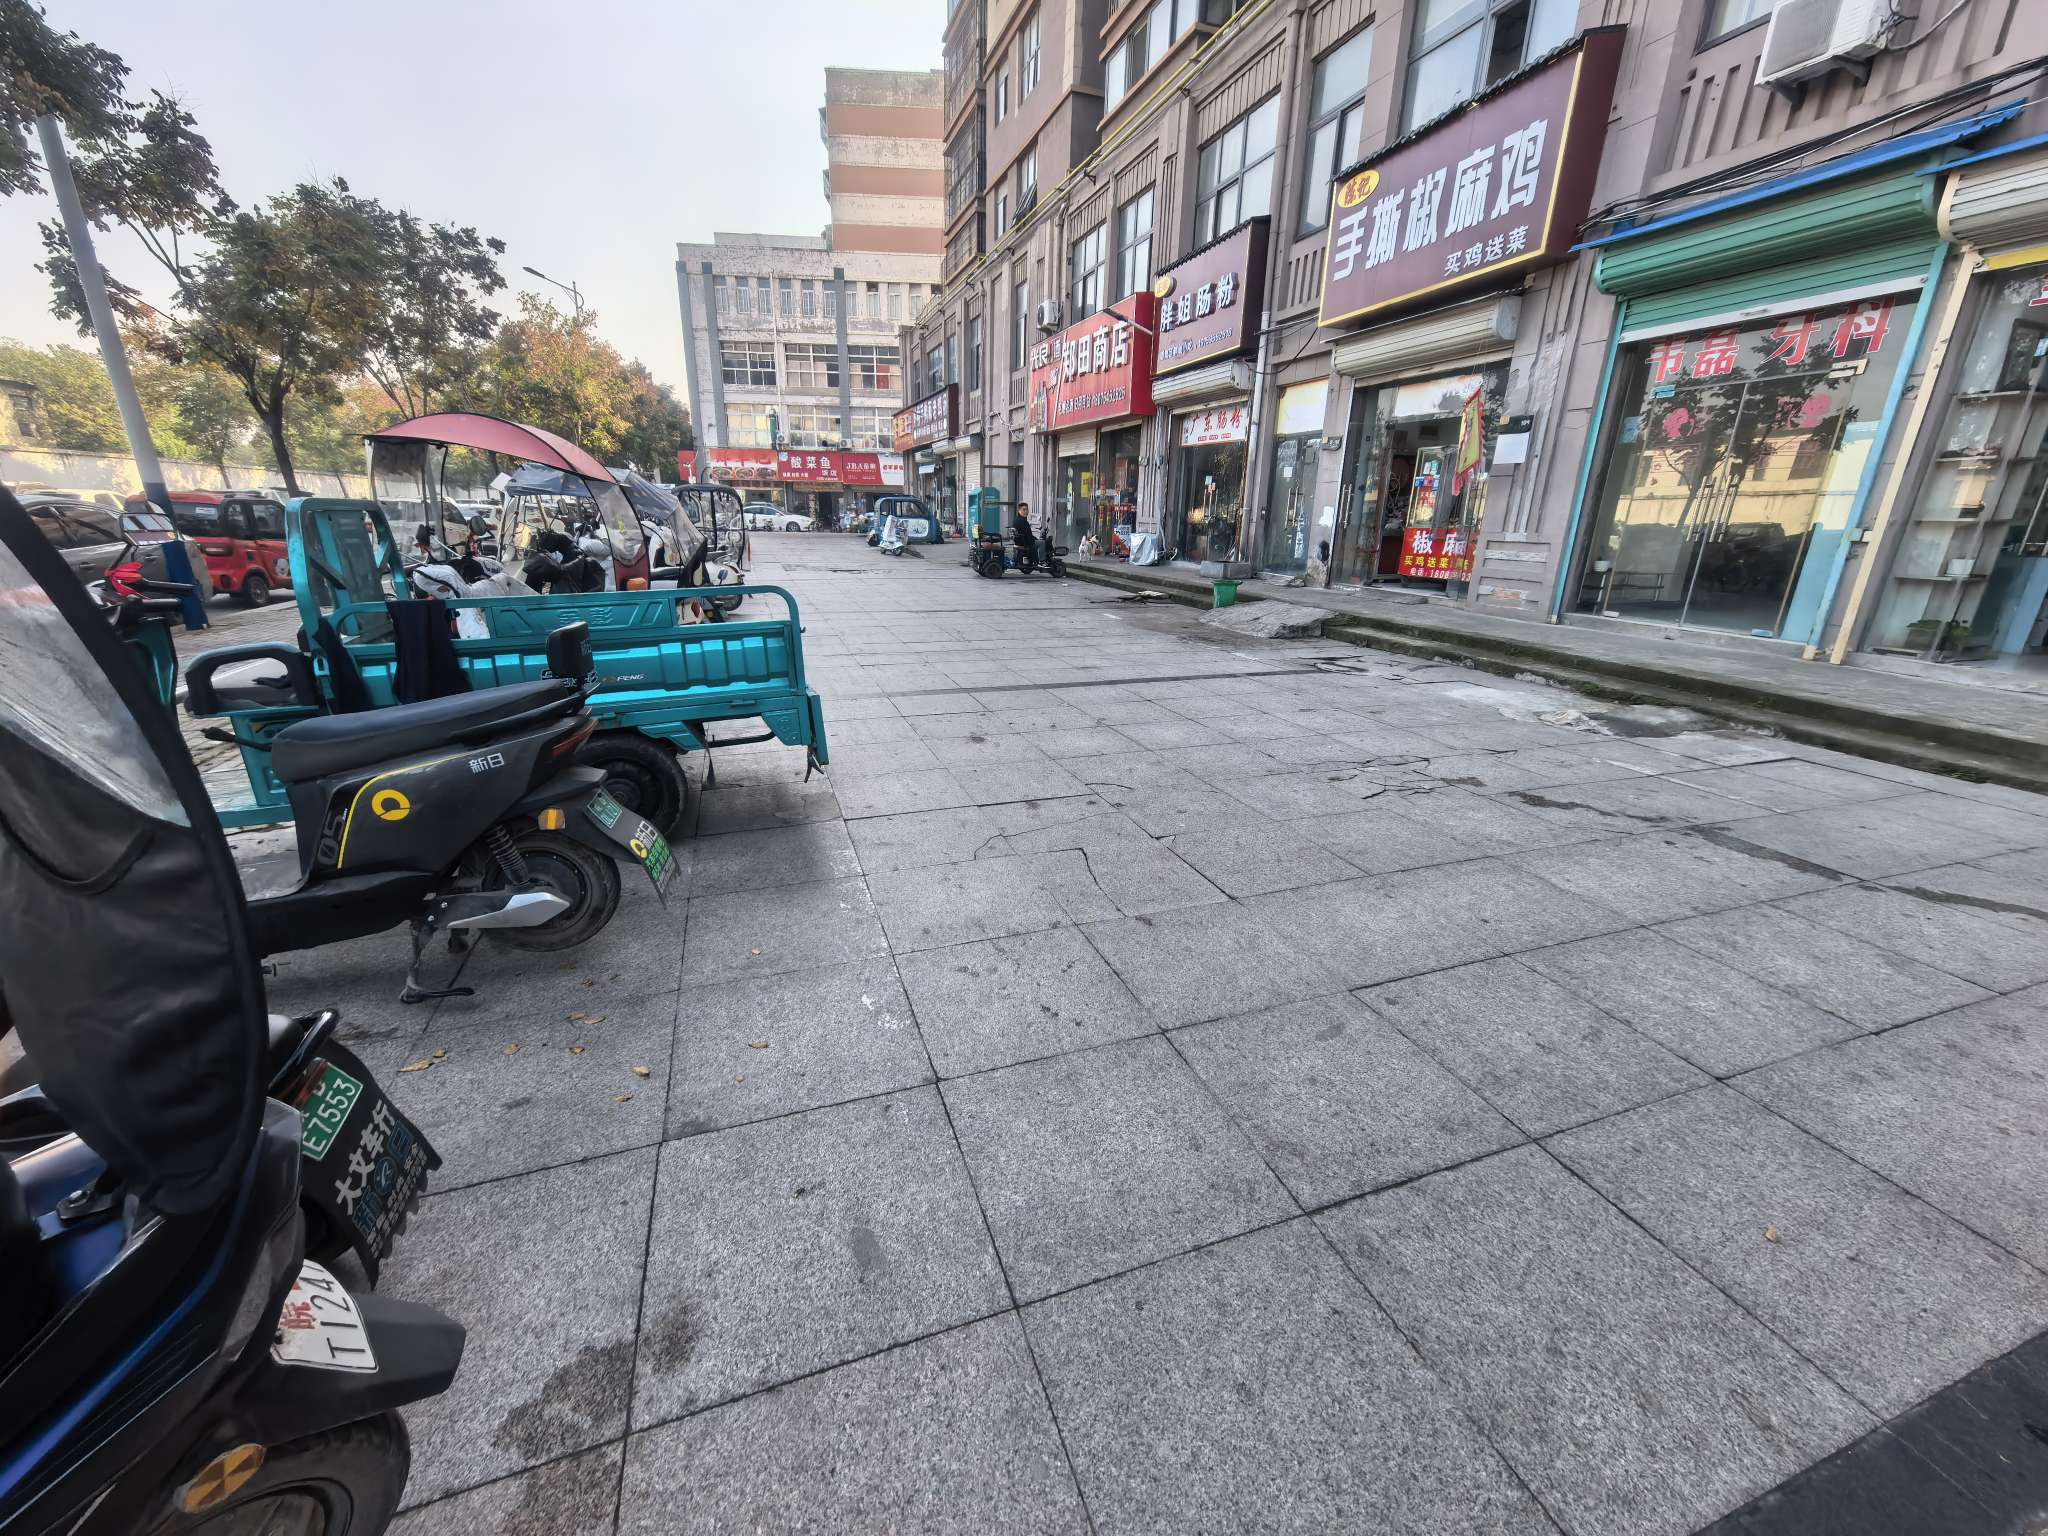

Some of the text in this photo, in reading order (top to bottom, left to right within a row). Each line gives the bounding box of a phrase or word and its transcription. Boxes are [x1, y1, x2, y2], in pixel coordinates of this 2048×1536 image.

[1333, 119, 1548, 281] 手撕椒麻鸡
[1443, 225, 1529, 276] 买鸡送菜
[1160, 272, 1239, 332] 胖姐肠粉
[790, 456, 831, 469] 酸菜鱼
[469, 753, 505, 773] 新日
[302, 1078, 356, 1152] E7553
[336, 1099, 395, 1216] 大文车行
